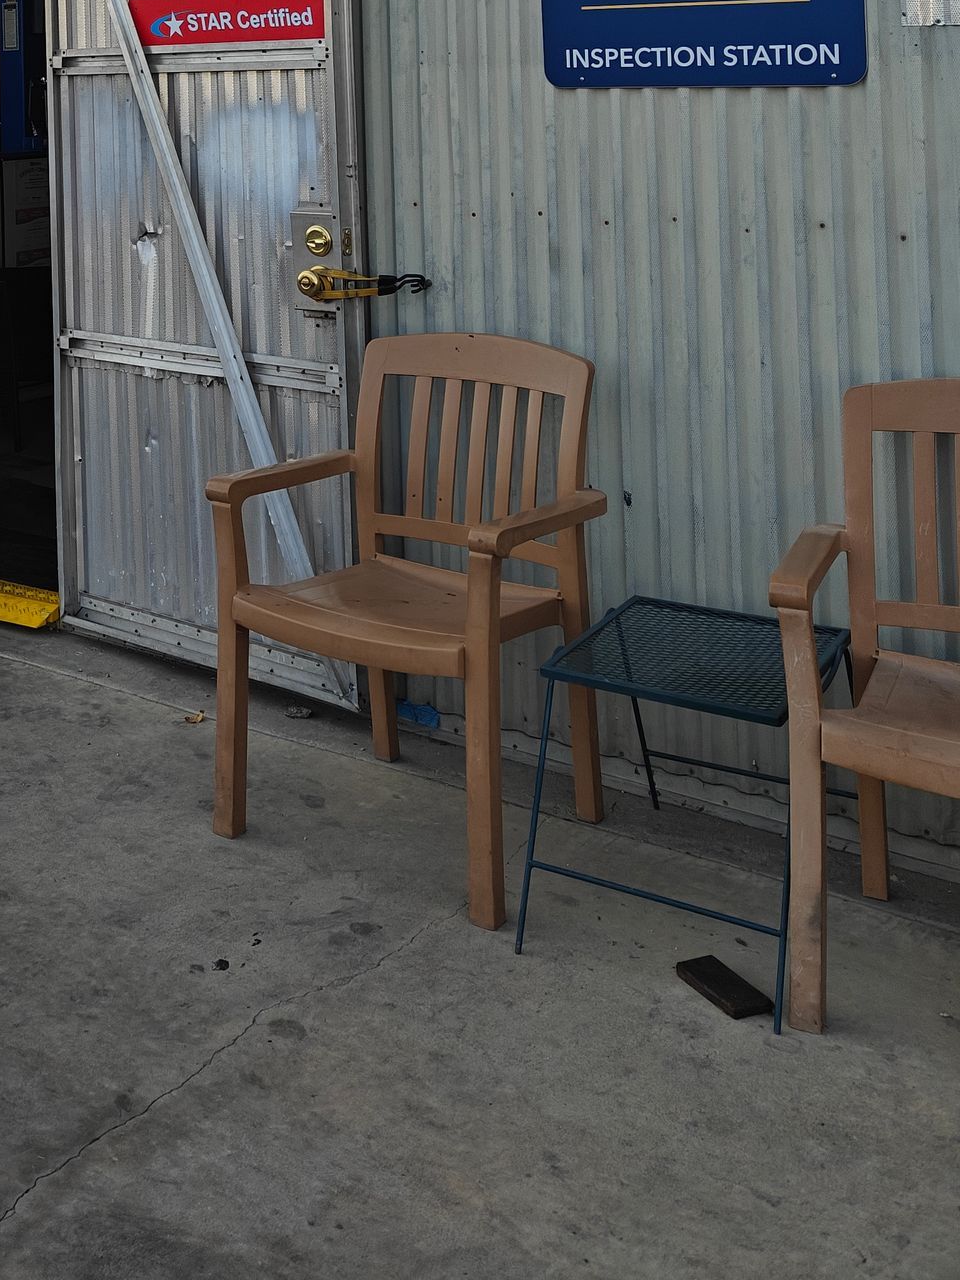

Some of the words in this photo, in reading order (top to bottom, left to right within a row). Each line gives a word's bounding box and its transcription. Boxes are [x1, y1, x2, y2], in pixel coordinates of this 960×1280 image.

[187, 11, 234, 31] STAR
[237, 6, 314, 29] Certified
[565, 46, 715, 69] INSPECTION
[723, 43, 840, 67] STATION
